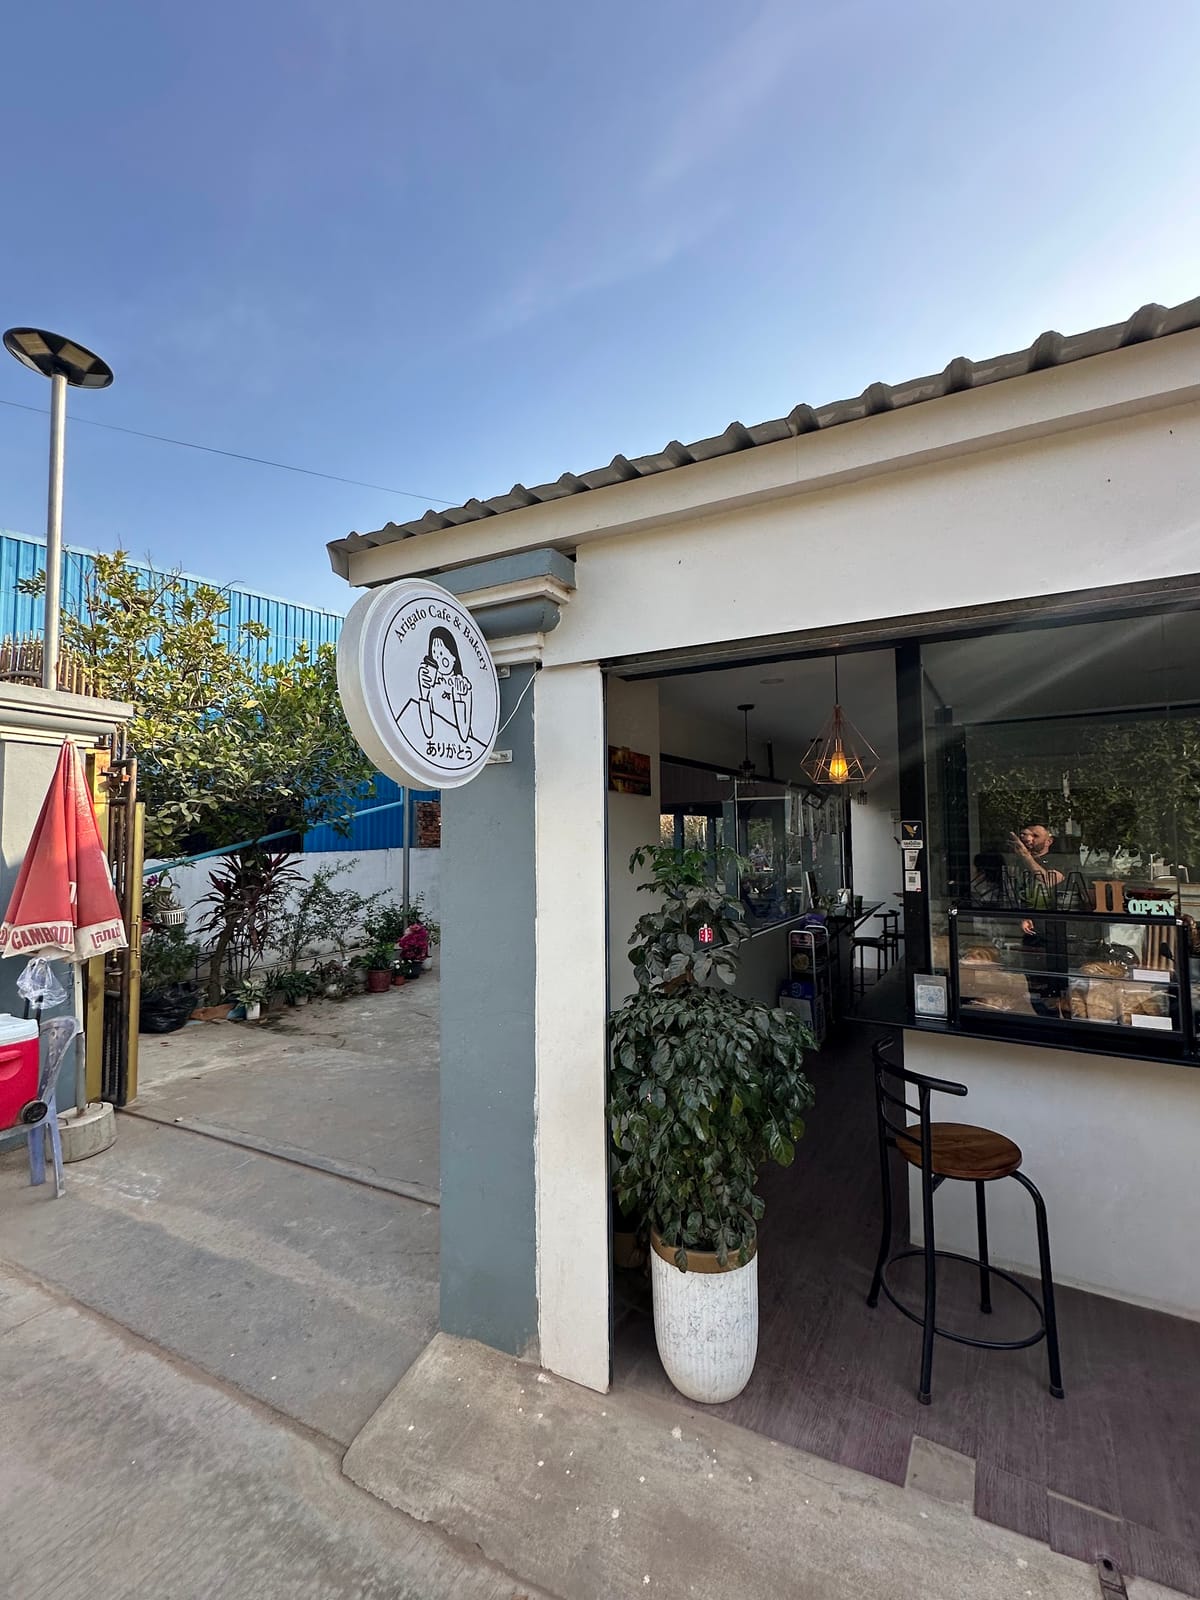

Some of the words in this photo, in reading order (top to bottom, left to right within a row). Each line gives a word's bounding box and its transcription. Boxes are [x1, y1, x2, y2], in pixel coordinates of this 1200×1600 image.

[394, 607, 427, 643] Arigato
[428, 604, 451, 623] Cafe
[453, 616, 462, 629] &
[462, 625, 488, 672] Bakery
[425, 740, 473, 761] ありがとう
[1128, 899, 1175, 916] OPEN
